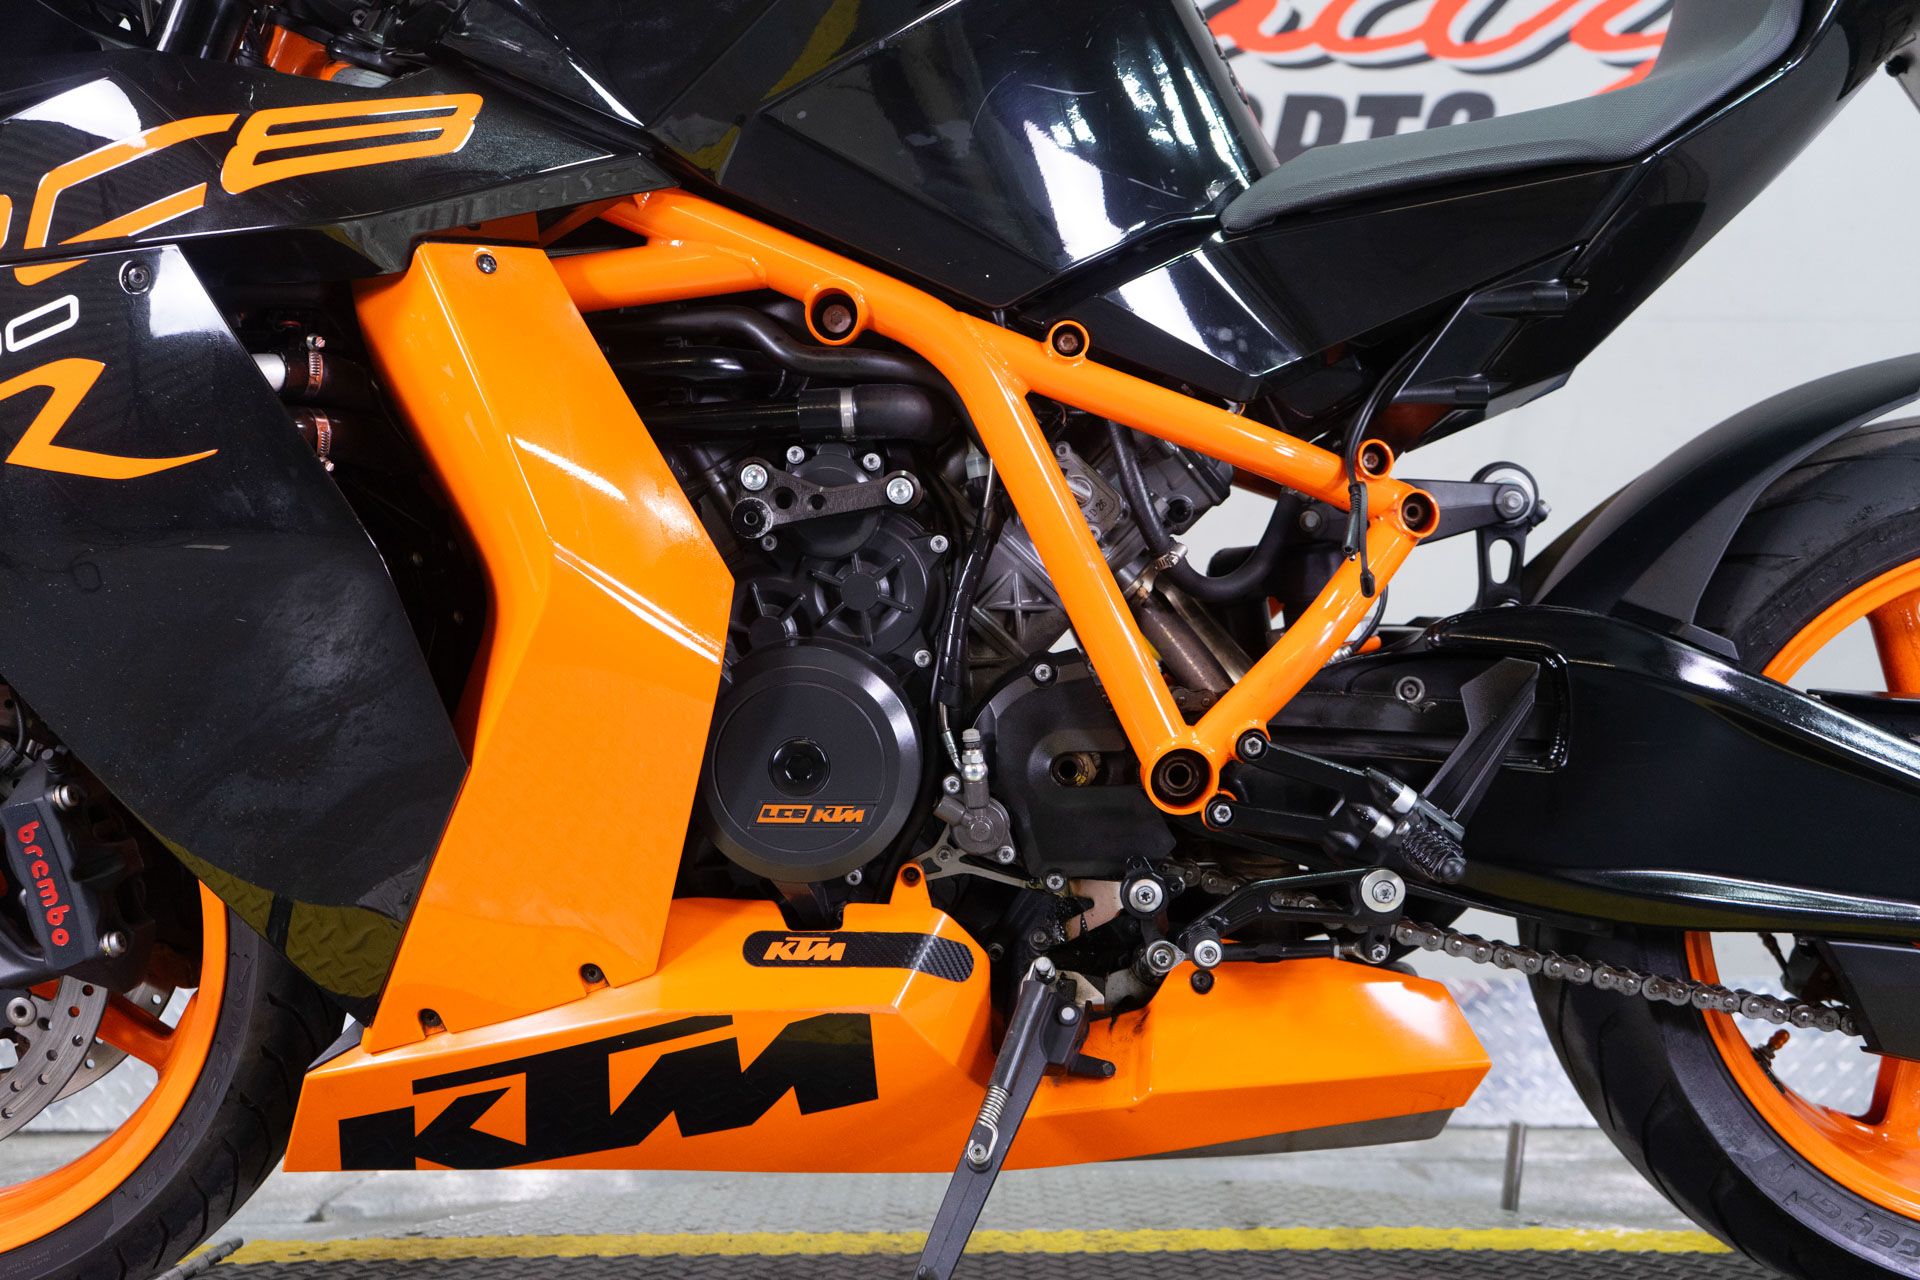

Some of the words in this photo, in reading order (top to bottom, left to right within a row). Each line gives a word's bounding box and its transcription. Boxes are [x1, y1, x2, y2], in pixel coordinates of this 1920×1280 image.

[0, 294, 80, 353] 0
[812, 805, 865, 823] KTM
[17, 821, 71, 946] brembo
[762, 937, 847, 961] KTM
[338, 1013, 879, 1171] KTM
